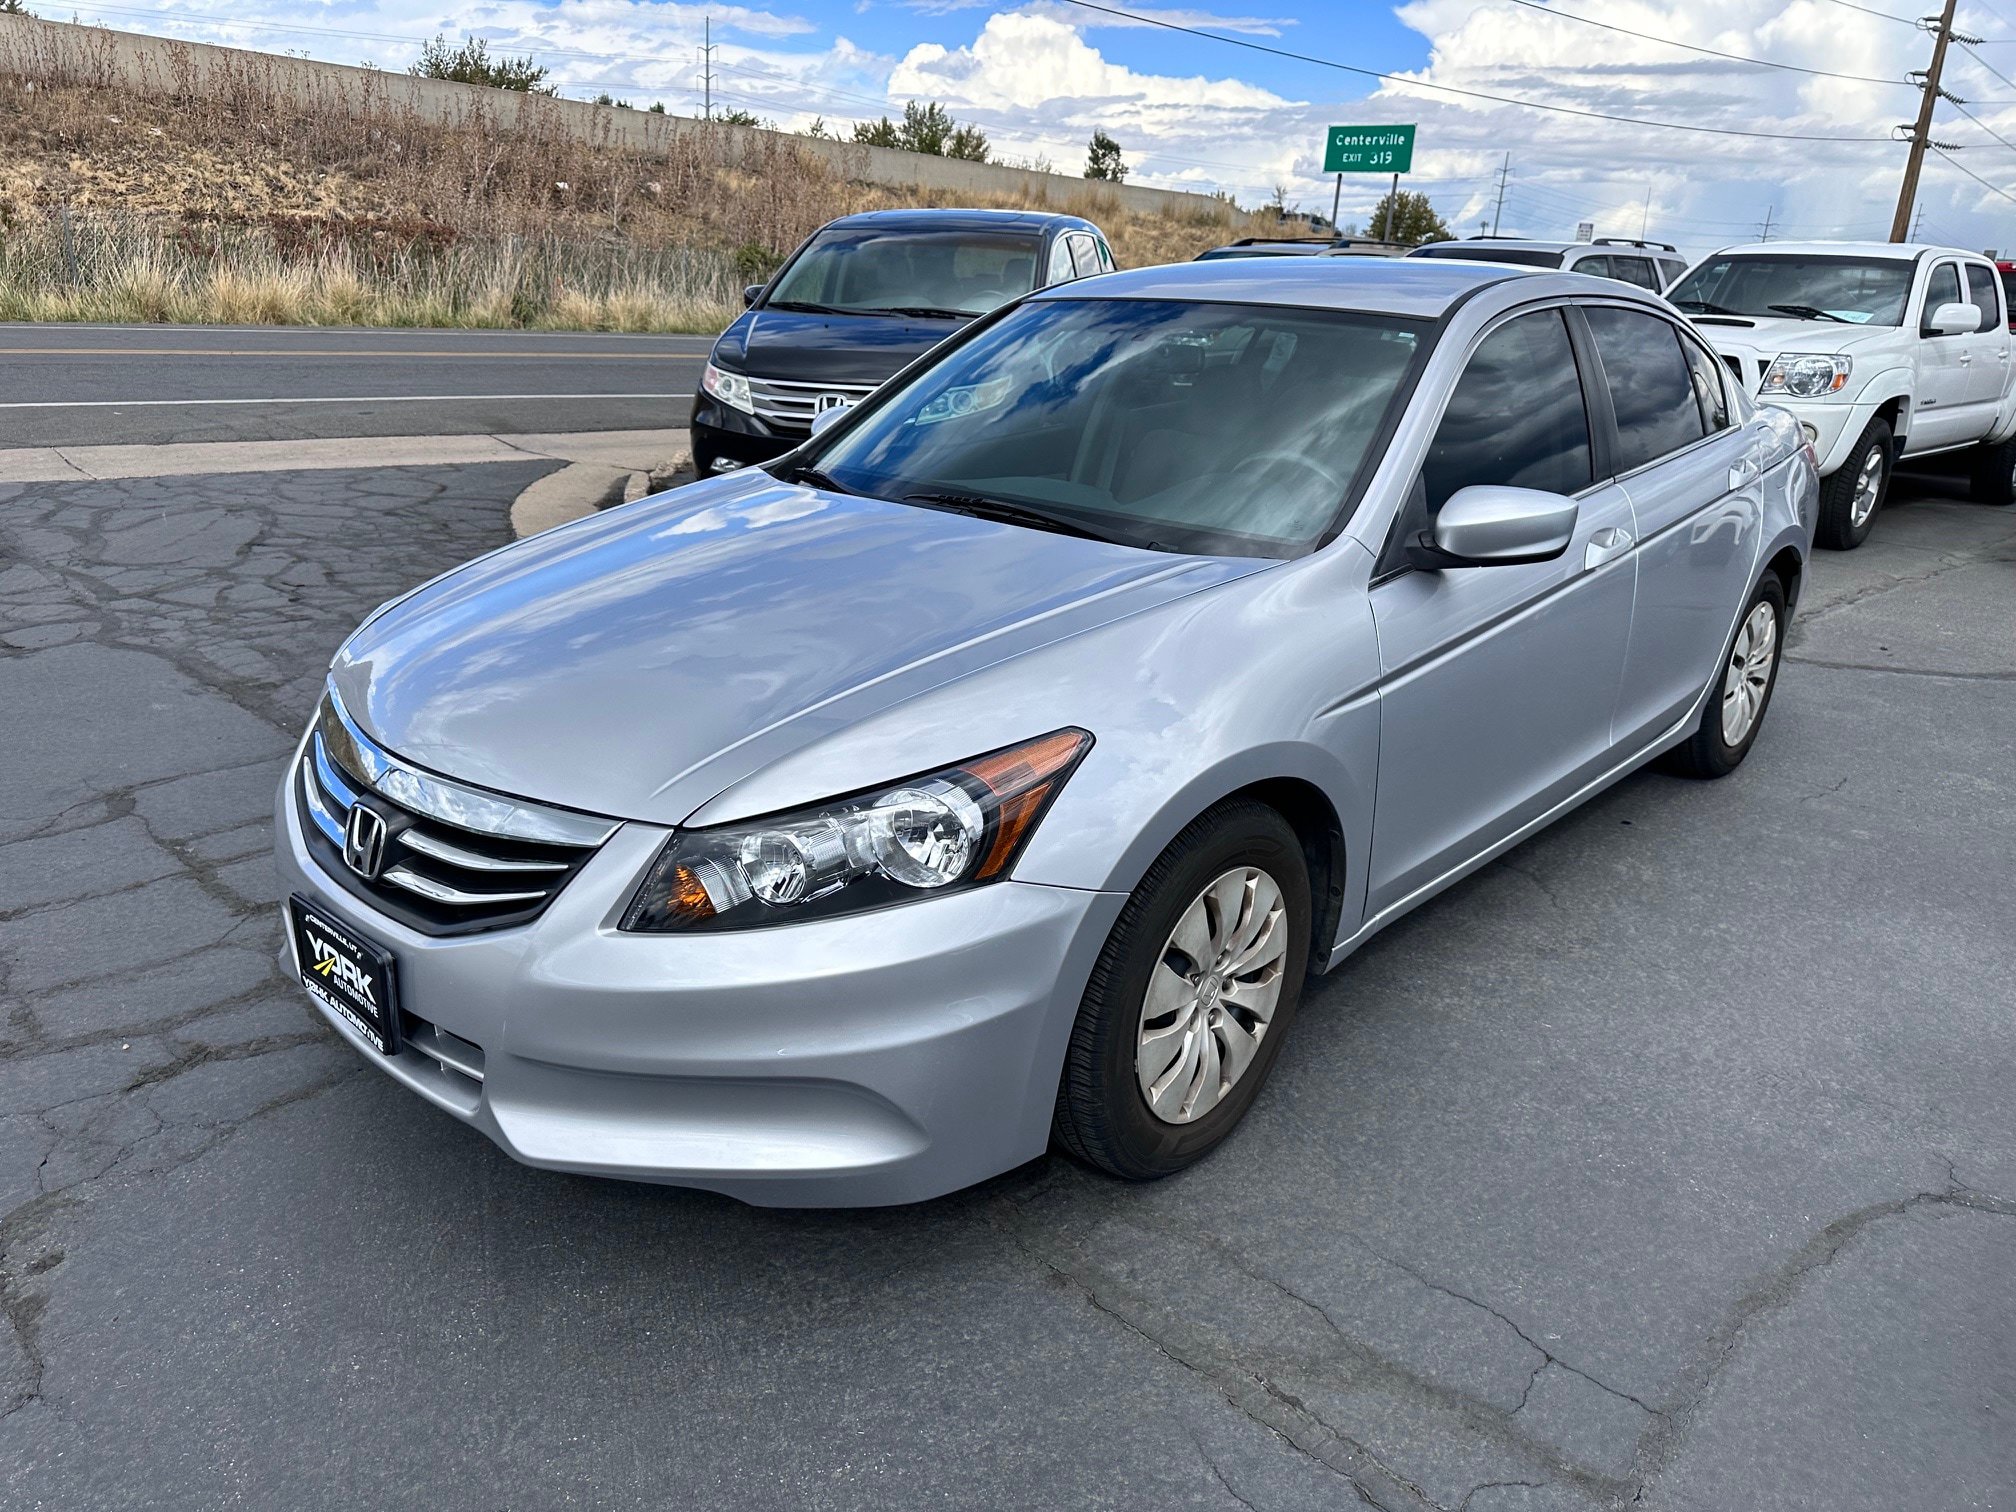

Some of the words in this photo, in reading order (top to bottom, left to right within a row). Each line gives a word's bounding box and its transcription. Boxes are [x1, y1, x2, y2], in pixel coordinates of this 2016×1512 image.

[1336, 133, 1405, 146] Centerville
[1342, 153, 1362, 162] EXIT
[1369, 151, 1393, 164] 319
[306, 930, 377, 1005] YORK
[302, 976, 329, 1003] YORK
[329, 995, 384, 1052] AUTOMOTIVE
[333, 975, 379, 1018] AUTOMOTIVE
